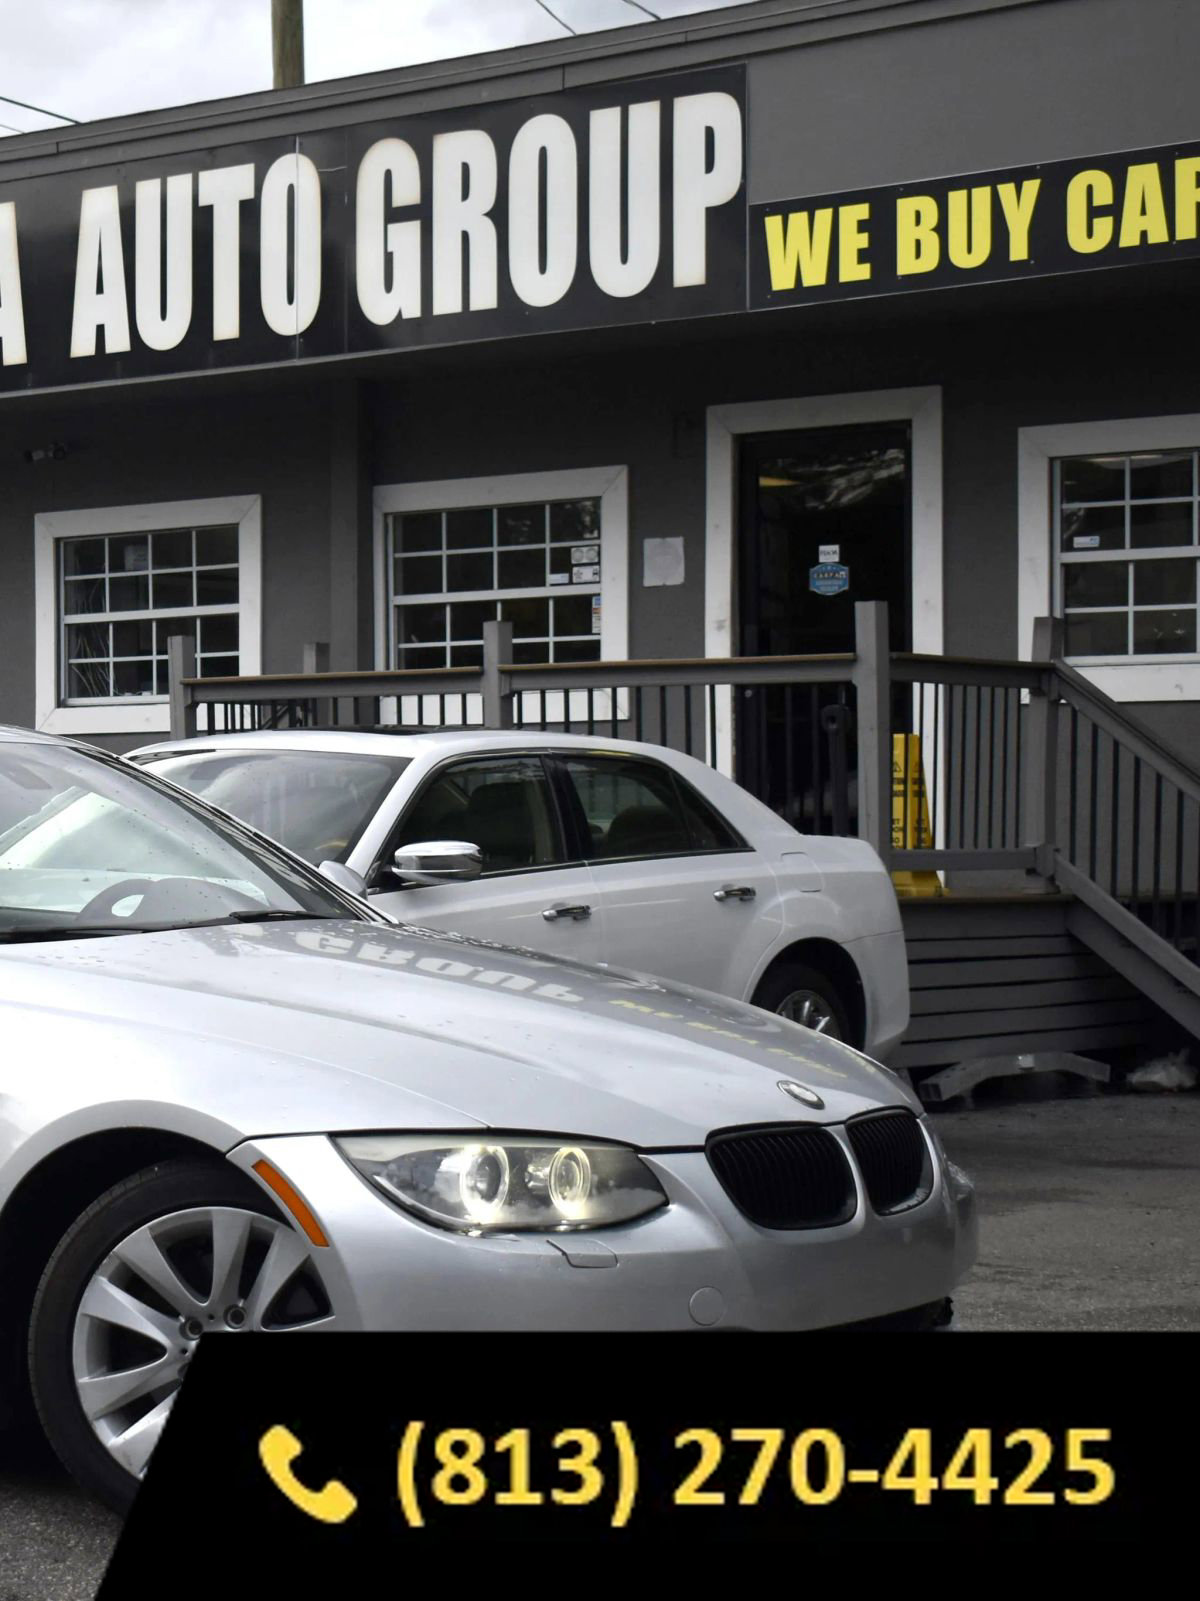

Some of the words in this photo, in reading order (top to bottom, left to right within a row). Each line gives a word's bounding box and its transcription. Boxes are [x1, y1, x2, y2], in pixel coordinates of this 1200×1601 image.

[70, 152, 322, 357] AUTO
[355, 92, 742, 326] GROUP
[764, 203, 872, 292] WE
[896, 178, 1041, 276] BUY
